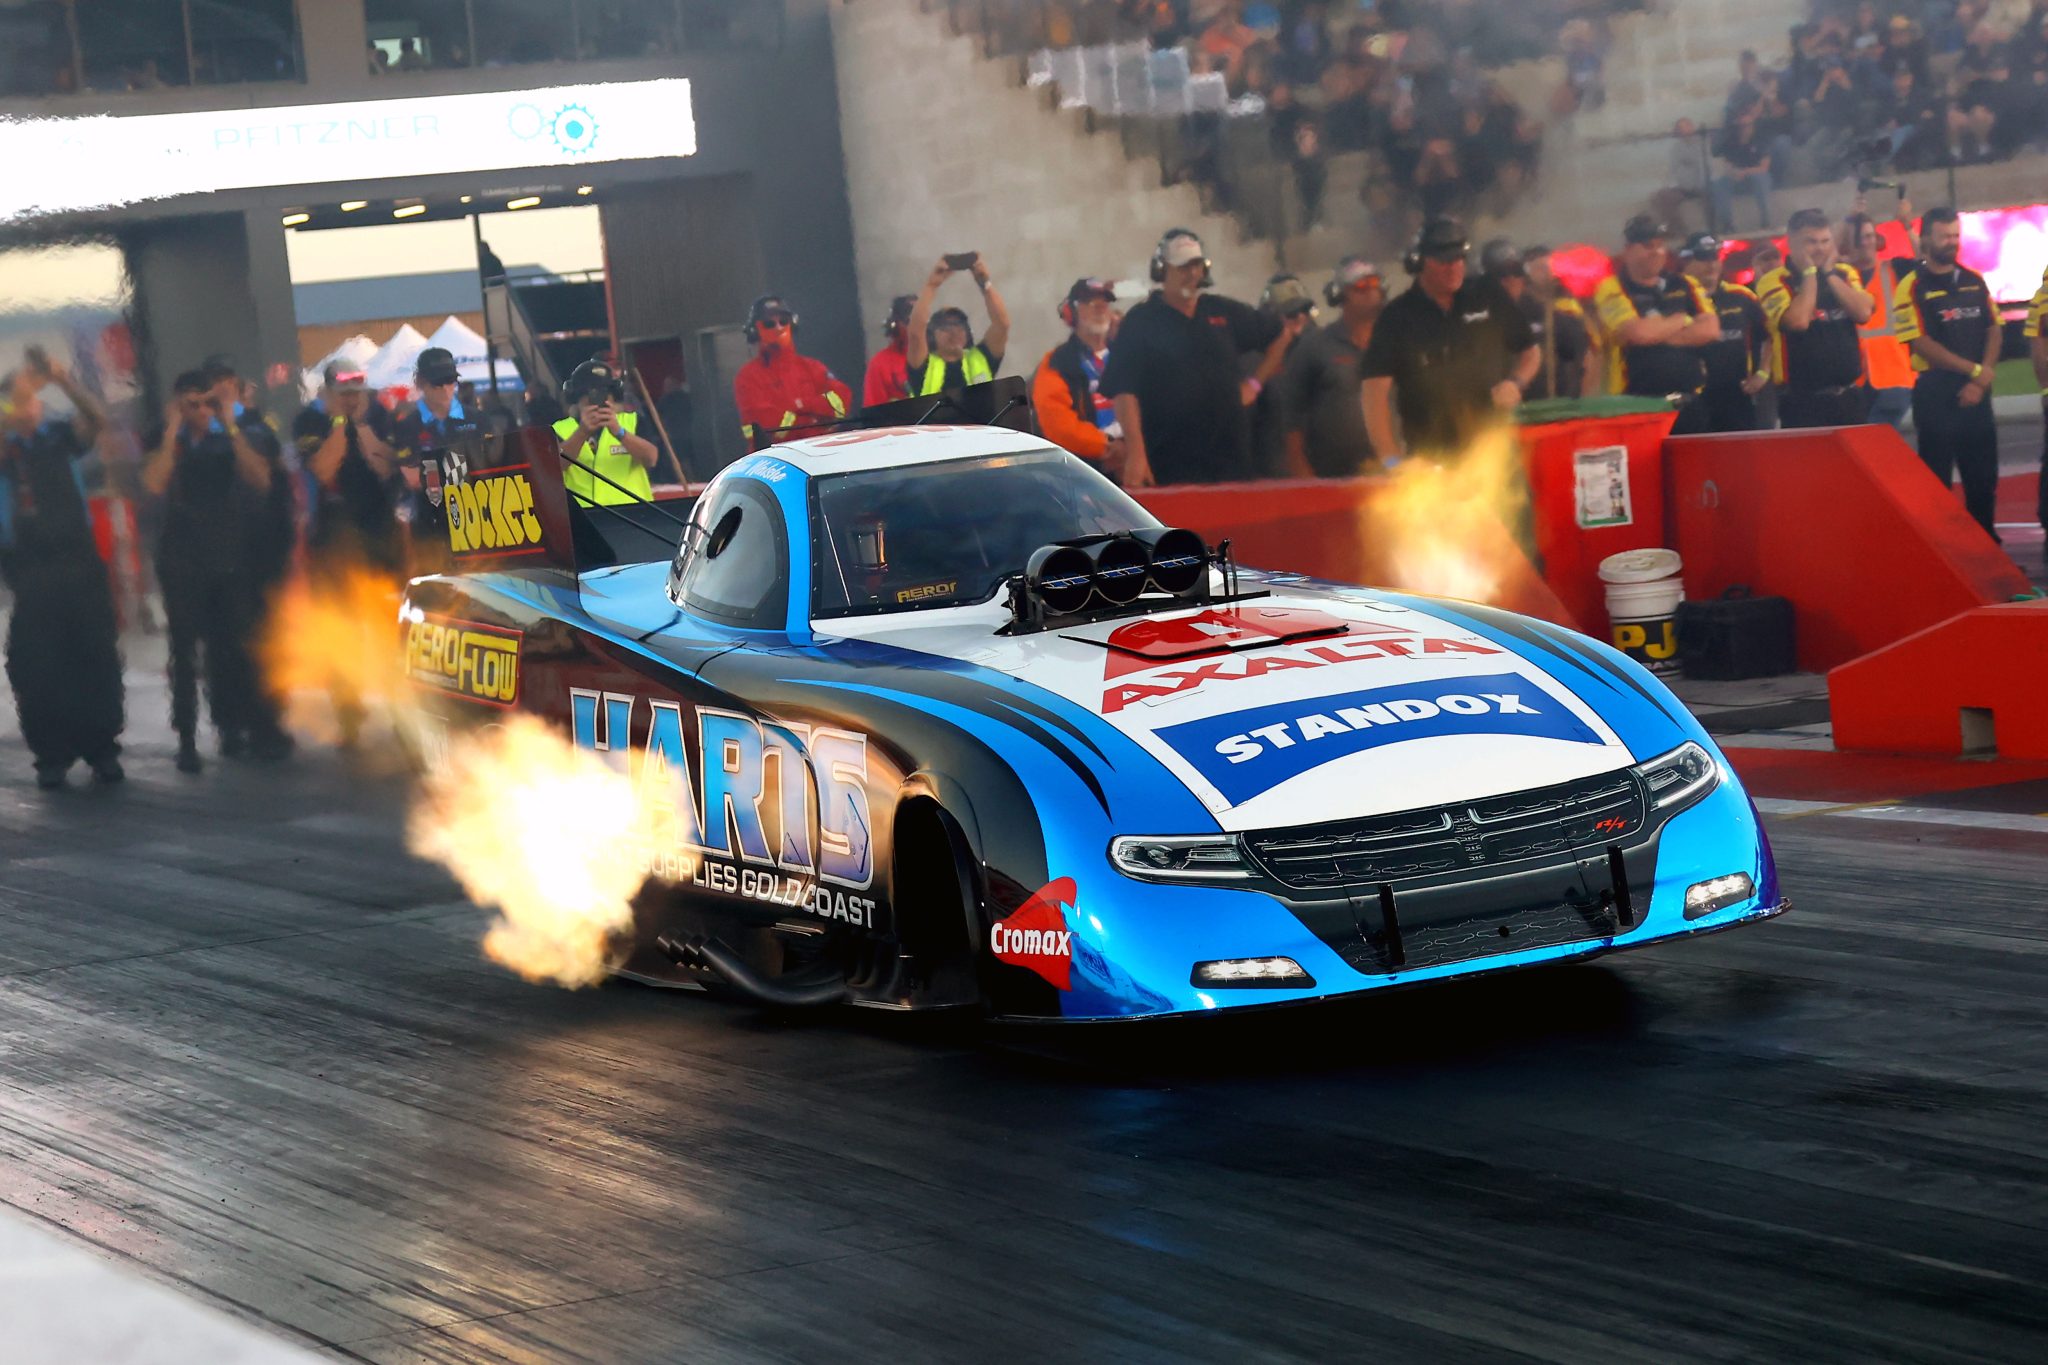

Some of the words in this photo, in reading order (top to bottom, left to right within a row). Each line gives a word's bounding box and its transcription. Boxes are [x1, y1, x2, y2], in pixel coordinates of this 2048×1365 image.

[213, 114, 440, 152] PFITZNER
[443, 474, 543, 552] ROCKET
[405, 621, 518, 701] AEROFLOW
[1101, 637, 1505, 714] AXALTA
[1215, 691, 1542, 764] STANDOX
[740, 868, 804, 908] GOLD
[802, 882, 876, 930] COAST
[989, 922, 1072, 957] Cromax
